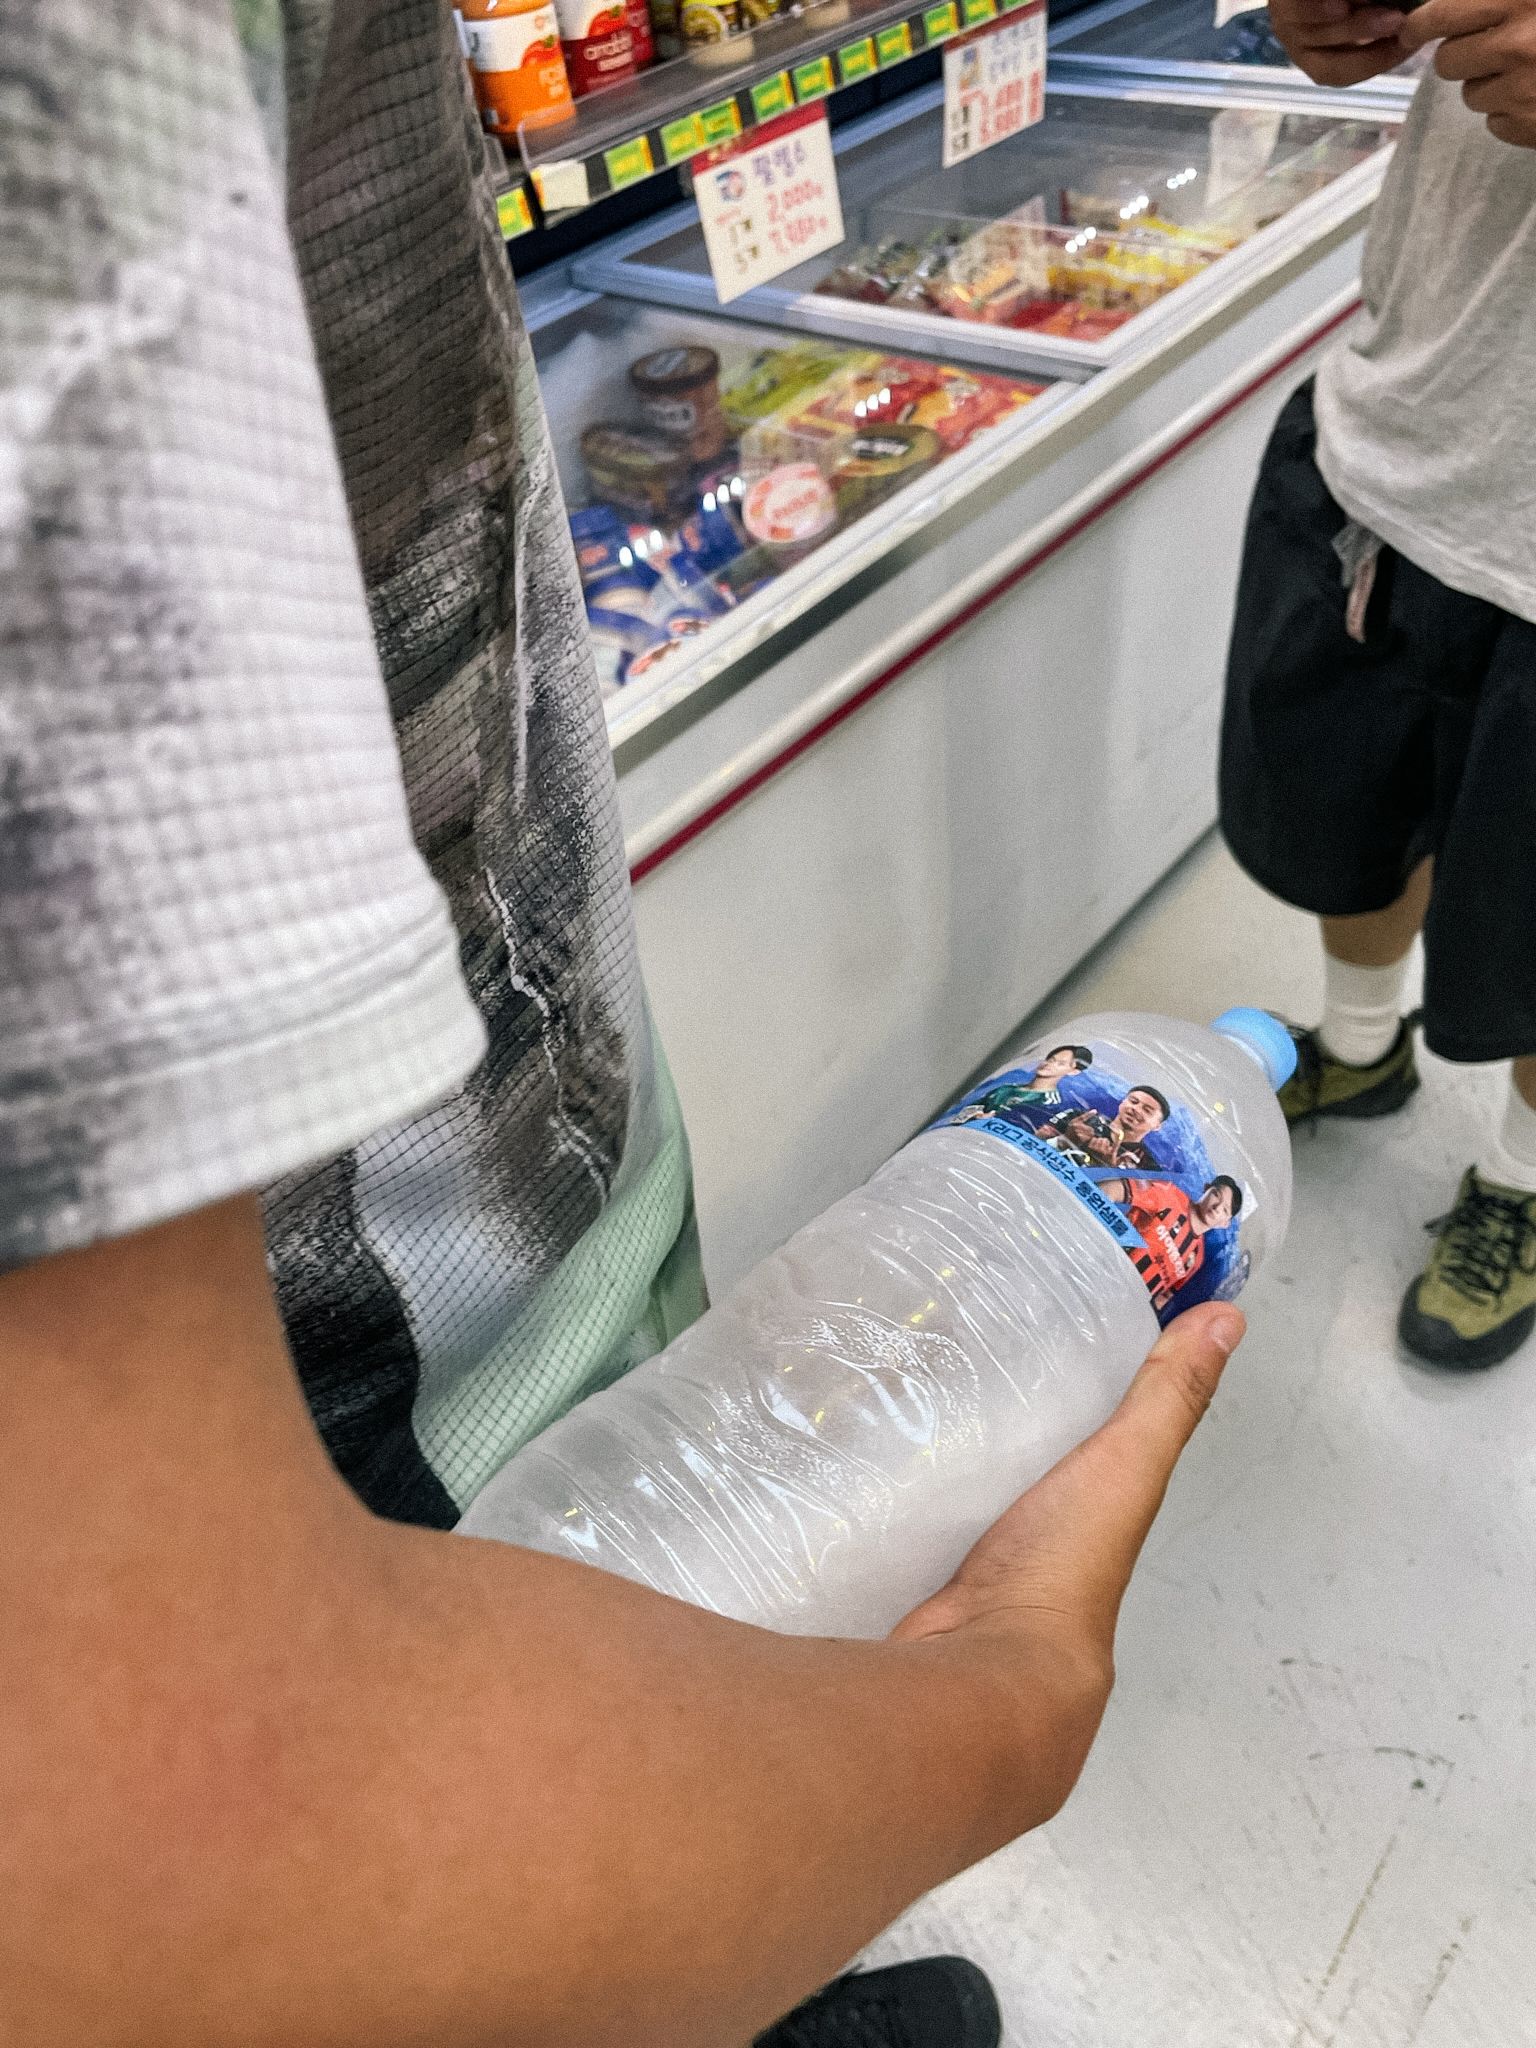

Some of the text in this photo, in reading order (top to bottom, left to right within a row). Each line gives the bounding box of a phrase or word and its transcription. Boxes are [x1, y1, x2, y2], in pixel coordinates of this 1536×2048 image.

[983, 1121, 1129, 1236] K리그 공식생수 동원샘물
